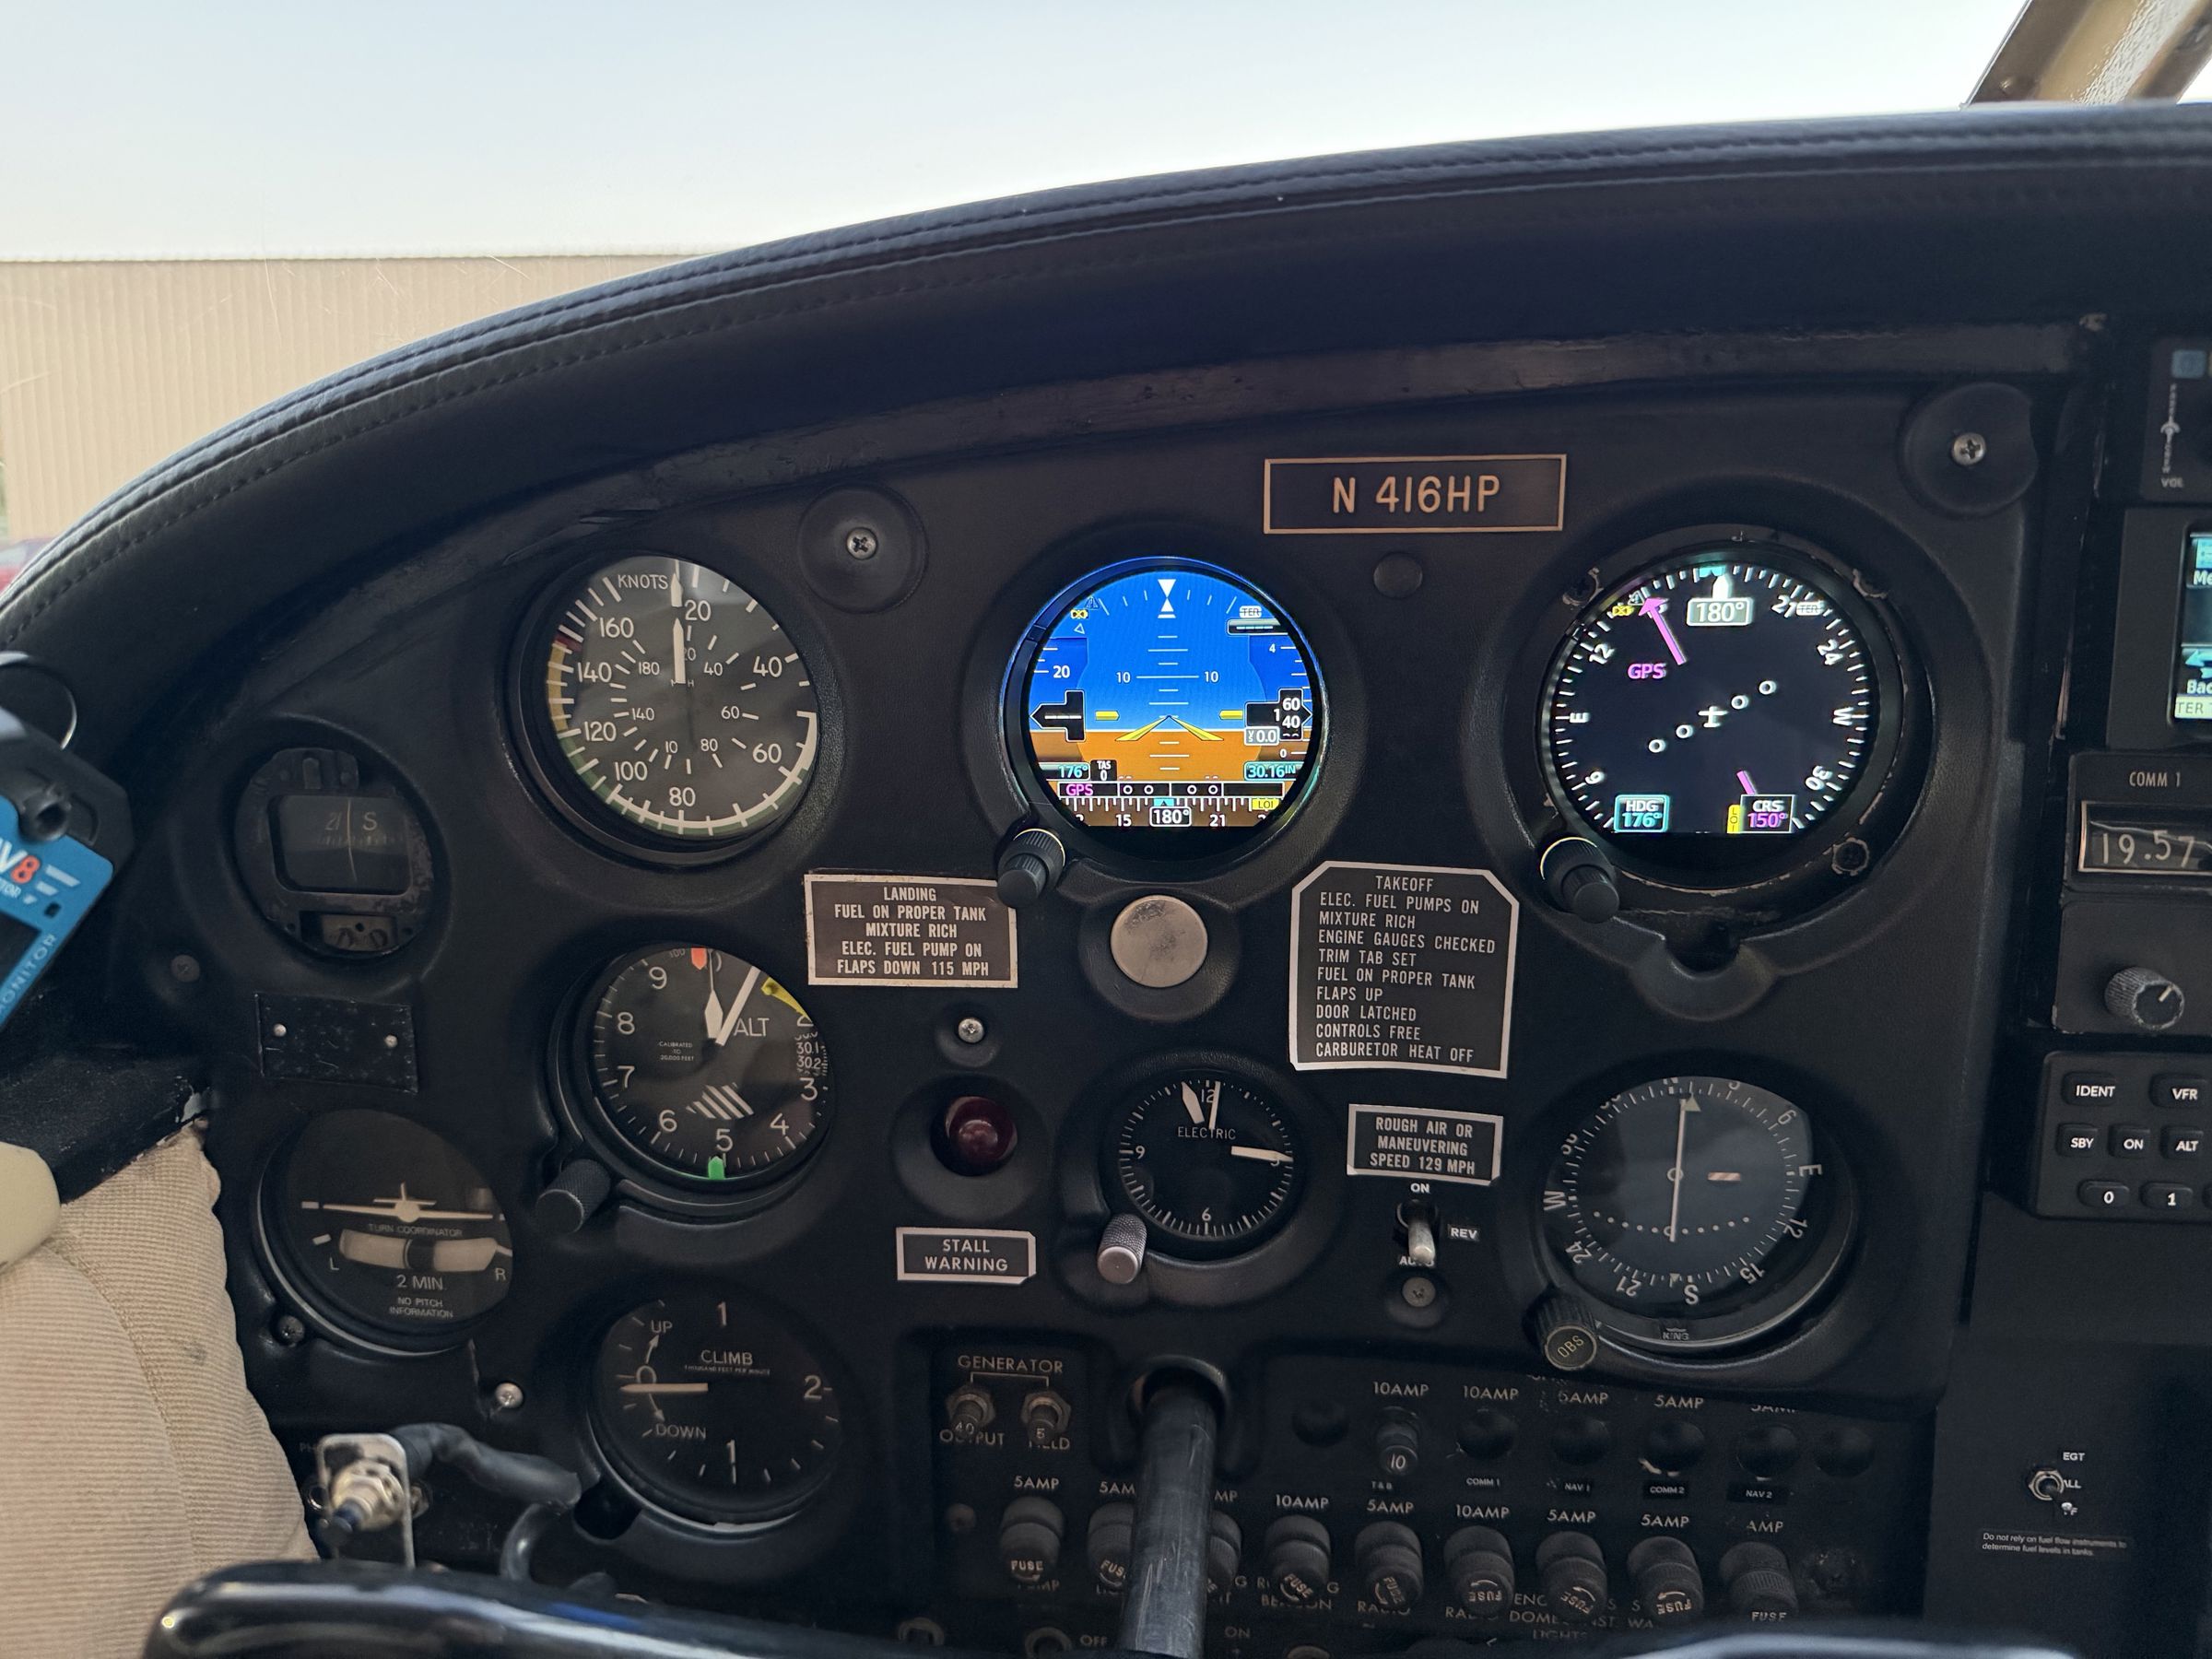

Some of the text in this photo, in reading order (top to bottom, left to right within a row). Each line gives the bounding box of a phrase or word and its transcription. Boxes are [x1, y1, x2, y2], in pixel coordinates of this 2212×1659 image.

[1334, 475, 1500, 512] N 416HP
[618, 574, 668, 589] KNOTS
[685, 601, 711, 621] 20
[600, 618, 634, 638] 160
[1589, 643, 1615, 665] 12
[1818, 642, 1842, 665] 24
[578, 662, 612, 683] 140
[638, 662, 660, 675] 180
[703, 663, 723, 676] 40
[753, 656, 782, 677] 40
[1053, 665, 1070, 678] 20
[1628, 664, 1665, 679] GPS
[1116, 672, 1131, 684] 10
[1205, 671, 1219, 683] 10
[632, 708, 655, 721] 140
[721, 707, 739, 719] 60
[584, 722, 617, 742] 120
[700, 739, 718, 751] 80
[752, 744, 782, 763] 60
[615, 761, 647, 781] 100
[1097, 761, 1112, 770] TAS
[2129, 771, 2181, 787] COMM 1
[669, 787, 696, 806] 80
[1066, 783, 1093, 796] GPS
[1258, 800, 1274, 809] LOI
[1625, 800, 1657, 813] HDG
[1753, 800, 1783, 813] CRS
[363, 812, 378, 830] S
[1116, 814, 1132, 827] 15
[1209, 814, 1226, 827] 21
[2103, 830, 2194, 868] 19.57
[1376, 876, 1433, 892] TAKEOFF
[884, 888, 936, 901] LANDING
[1320, 892, 1479, 914] ELEC. FUEL PUMPS ON
[835, 904, 986, 921] FUEL ON PROPER TANK
[1320, 912, 1416, 929] MIXTURE RICH
[865, 924, 958, 938] MIXTURE RICH
[841, 941, 982, 957] ELEC. FUEL PUMP ON
[1319, 930, 1495, 954] ENGINE GAUGES CHECKED
[1319, 948, 1417, 967] TRIM TAB SET
[838, 959, 989, 976] FLAPS DOWN 115 MPH
[649, 967, 667, 990] 9
[1318, 967, 1476, 989] FUEL ON PROPER TANK
[1317, 986, 1382, 1001] FLAPS UP
[1316, 1005, 1416, 1021] DOOR LATCHED
[618, 1012, 635, 1035] 8
[733, 1018, 770, 1037] ALT
[1316, 1024, 1420, 1040] CONTROLS FREE
[1316, 1042, 1474, 1063] CARBURETOR HEAT OFF
[618, 1065, 635, 1088] 7
[799, 1077, 818, 1100] 3
[2076, 1085, 2115, 1098] IDENT
[2172, 1088, 2197, 1100] VFR
[659, 1110, 677, 1132] 6
[770, 1113, 789, 1135] 4
[1376, 1117, 1473, 1138] ROUGH AIR OR
[716, 1128, 733, 1152] 5
[1178, 1126, 1236, 1139] ELECTRIC
[1378, 1135, 1467, 1156] MANEUVERING
[2071, 1137, 2094, 1148] SBY
[2124, 1139, 2143, 1149] ON
[2176, 1140, 2198, 1152] ALT
[1135, 1146, 1145, 1159] 9
[1371, 1153, 1475, 1175] SPEED 129 MPH
[1799, 1163, 1822, 1177] E
[1411, 1182, 1430, 1194] ON
[2104, 1192, 2114, 1204] 0
[2168, 1193, 2176, 1206] 1
[1202, 1207, 1211, 1221] 6
[369, 1224, 463, 1236] TURN COORDINATOR
[1451, 1228, 1477, 1240] REV
[943, 1239, 990, 1253] STALL
[330, 1257, 339, 1270] L
[924, 1256, 1008, 1272] WARNING
[396, 1275, 407, 1288] 2
[495, 1268, 506, 1280] R
[398, 1297, 443, 1307] NO PITCH
[390, 1307, 453, 1318] INFORMATION
[718, 1301, 726, 1326] 1
[651, 1320, 673, 1333] UP
[1557, 1335, 1584, 1359] OBS
[700, 1350, 753, 1365] CLIMB
[959, 1355, 1063, 1372] GENERATOR
[805, 1375, 822, 1399] 2
[1372, 1382, 1429, 1396] 10AMP
[1463, 1385, 1519, 1401] 10AMP
[1654, 1394, 1704, 1409] 5AMP
[656, 1424, 706, 1438] DOWN
[2063, 1453, 2085, 1461] EGT
[1015, 1476, 1059, 1490] 5AMP
[1466, 1477, 1493, 1486] COMM
[1565, 1483, 1583, 1491] NAV
[1746, 1489, 1764, 1499] NAV
[1276, 1494, 1329, 1510] 10AMP
[1367, 1499, 1414, 1513] 5AMP
[1456, 1504, 1510, 1519] 10AMP
[1547, 1510, 1596, 1524] 5AMP
[1641, 1513, 1689, 1528] 5AMP
[1983, 1543, 2020, 1551] determine
[2010, 1535, 2025, 1544] rely
[2054, 1536, 2071, 1545] flow
[1011, 1560, 1043, 1571] FUSE
[1284, 1573, 1313, 1598] FUSE
